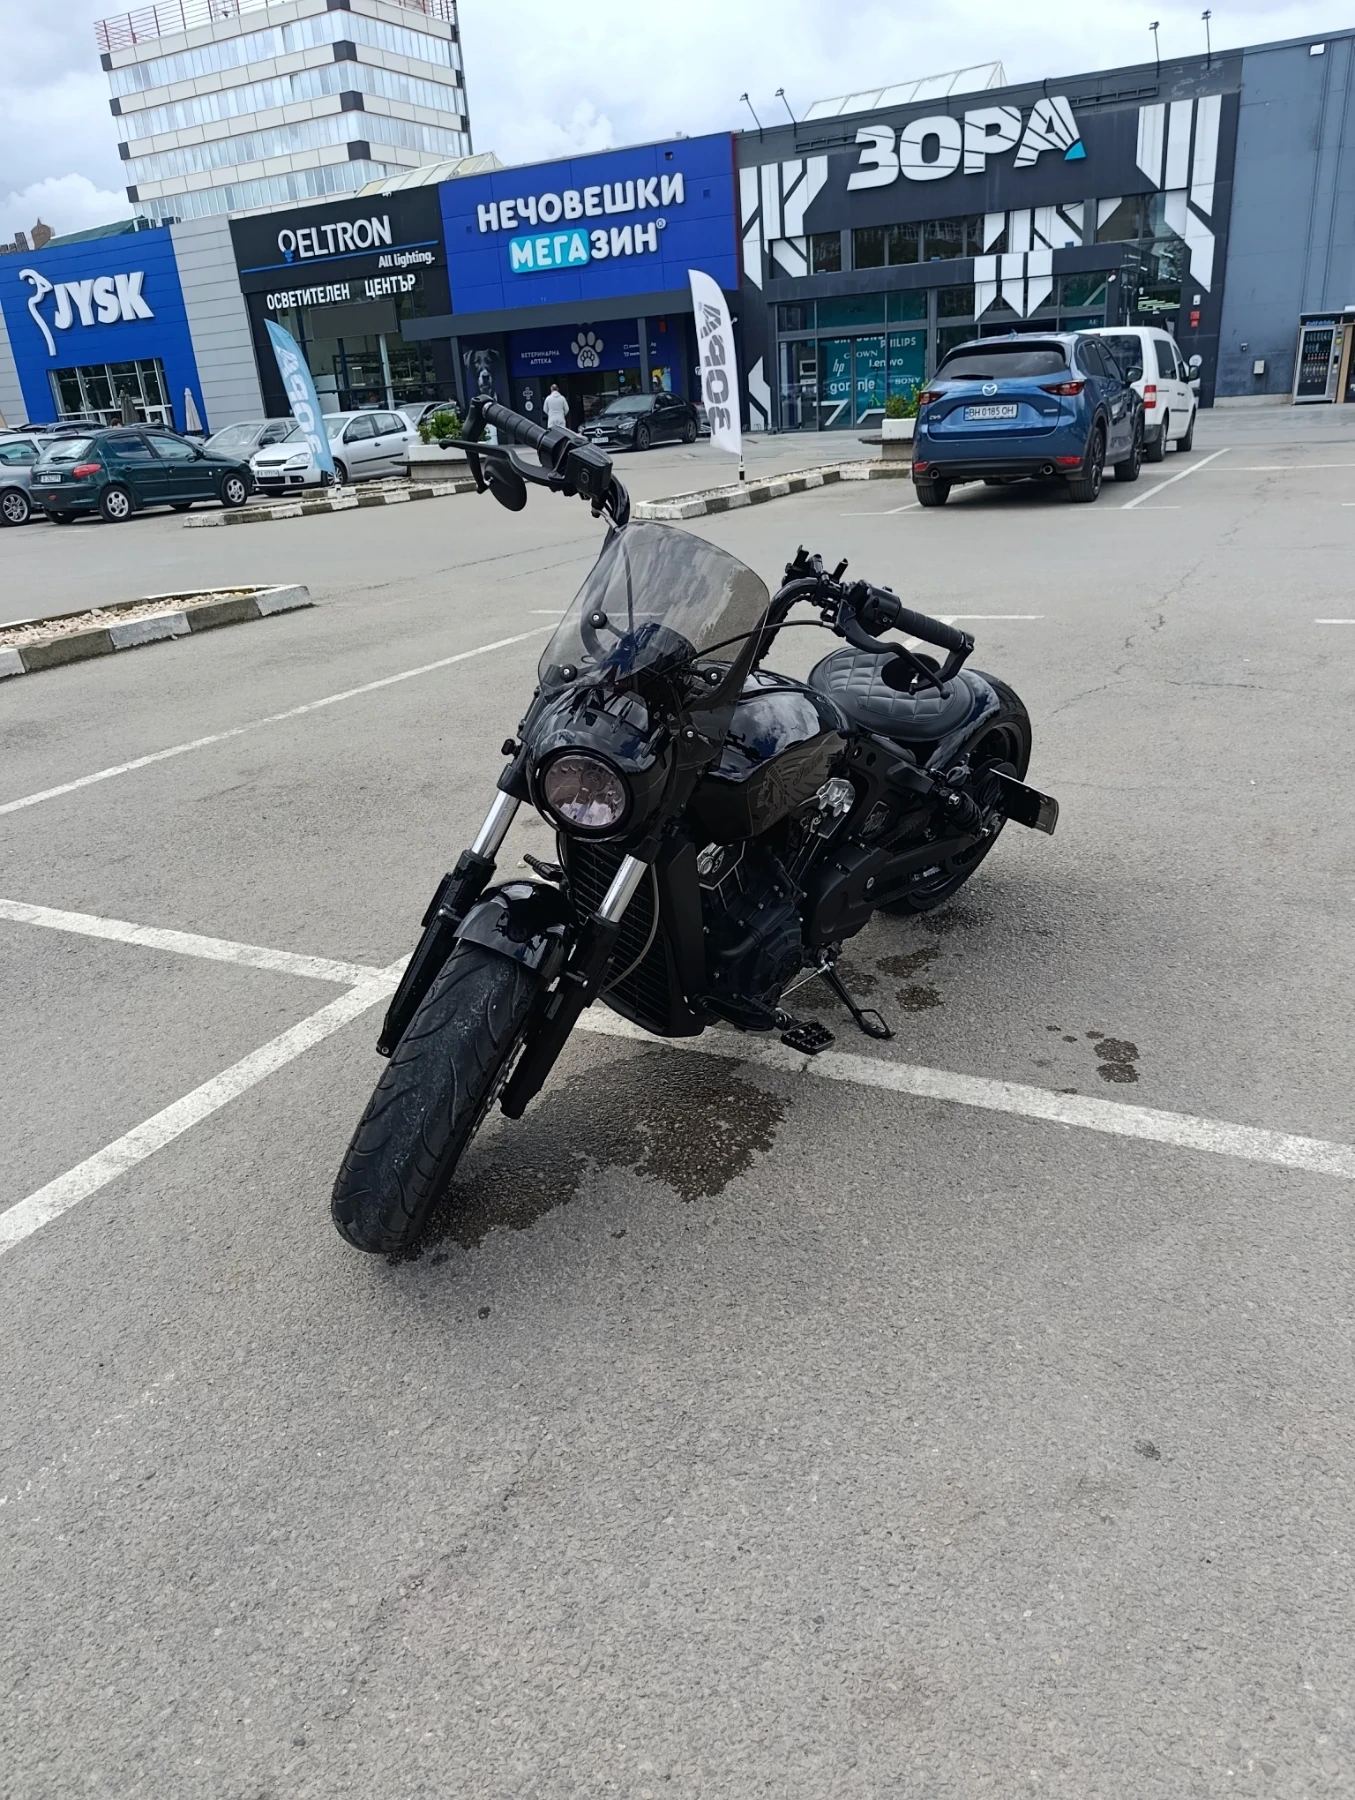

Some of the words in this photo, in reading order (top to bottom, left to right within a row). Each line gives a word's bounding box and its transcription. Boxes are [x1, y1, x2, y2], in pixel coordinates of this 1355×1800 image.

[846, 95, 1086, 191] ЗОРА
[477, 172, 685, 233] НЕЧОВЕШКИ
[378, 255, 393, 268] All
[53, 271, 155, 330] JYSK
[266, 283, 350, 311] ОСВЕТИТЕЛЕН
[364, 274, 416, 298] ЦЕНТЪР
[843, 350, 878, 359] COWN
[868, 358, 904, 367] Lenvo
[832, 359, 845, 377] hp
[830, 378, 875, 395] gornje
[969, 407, 981, 418] BH
[982, 406, 1000, 416] 0185
[1001, 406, 1014, 415] OH
